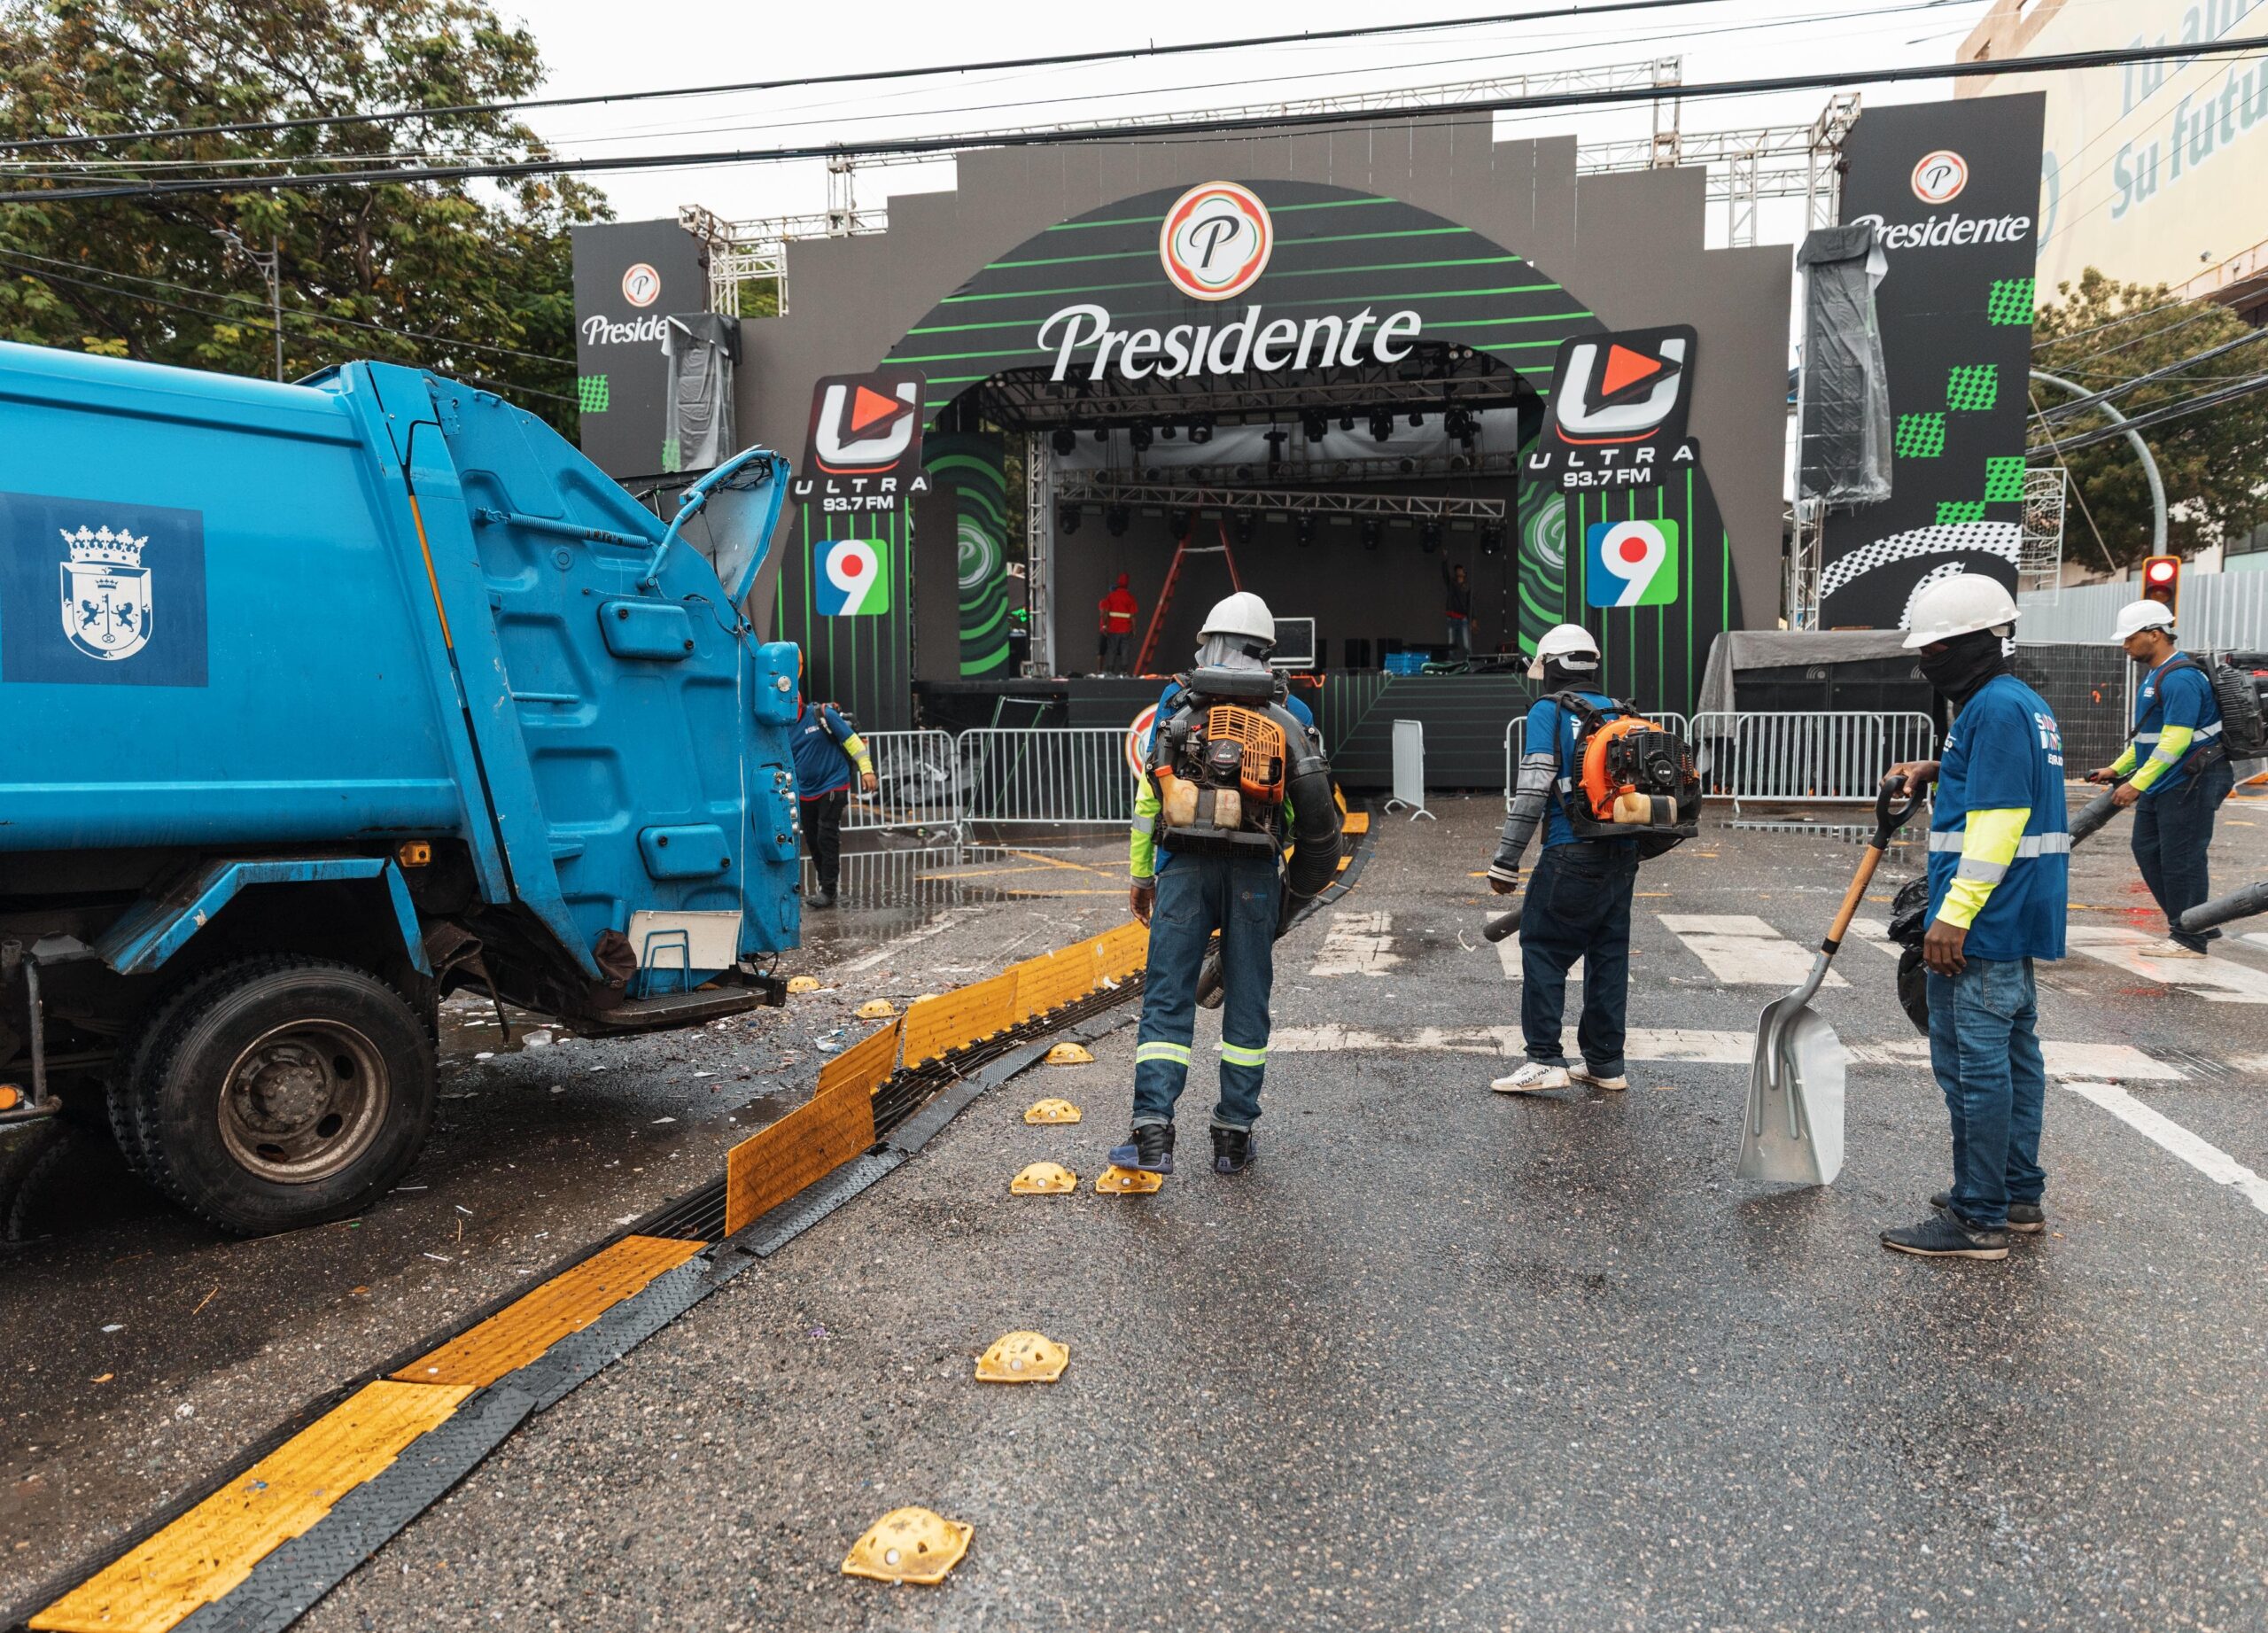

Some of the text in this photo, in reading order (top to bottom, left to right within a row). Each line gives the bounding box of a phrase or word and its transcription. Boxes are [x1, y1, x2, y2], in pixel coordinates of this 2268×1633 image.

[2112, 142, 2158, 220] Su
[1189, 215, 1240, 269] P
[1037, 304, 1422, 381] Presidente
[1529, 445, 1694, 470] ULTRA
[1563, 467, 1651, 487] 93.7 FM
[795, 476, 928, 494] ULTRA
[823, 495, 894, 511] 93.7 FM
[826, 539, 878, 616] 9
[1601, 520, 1666, 607] 9
